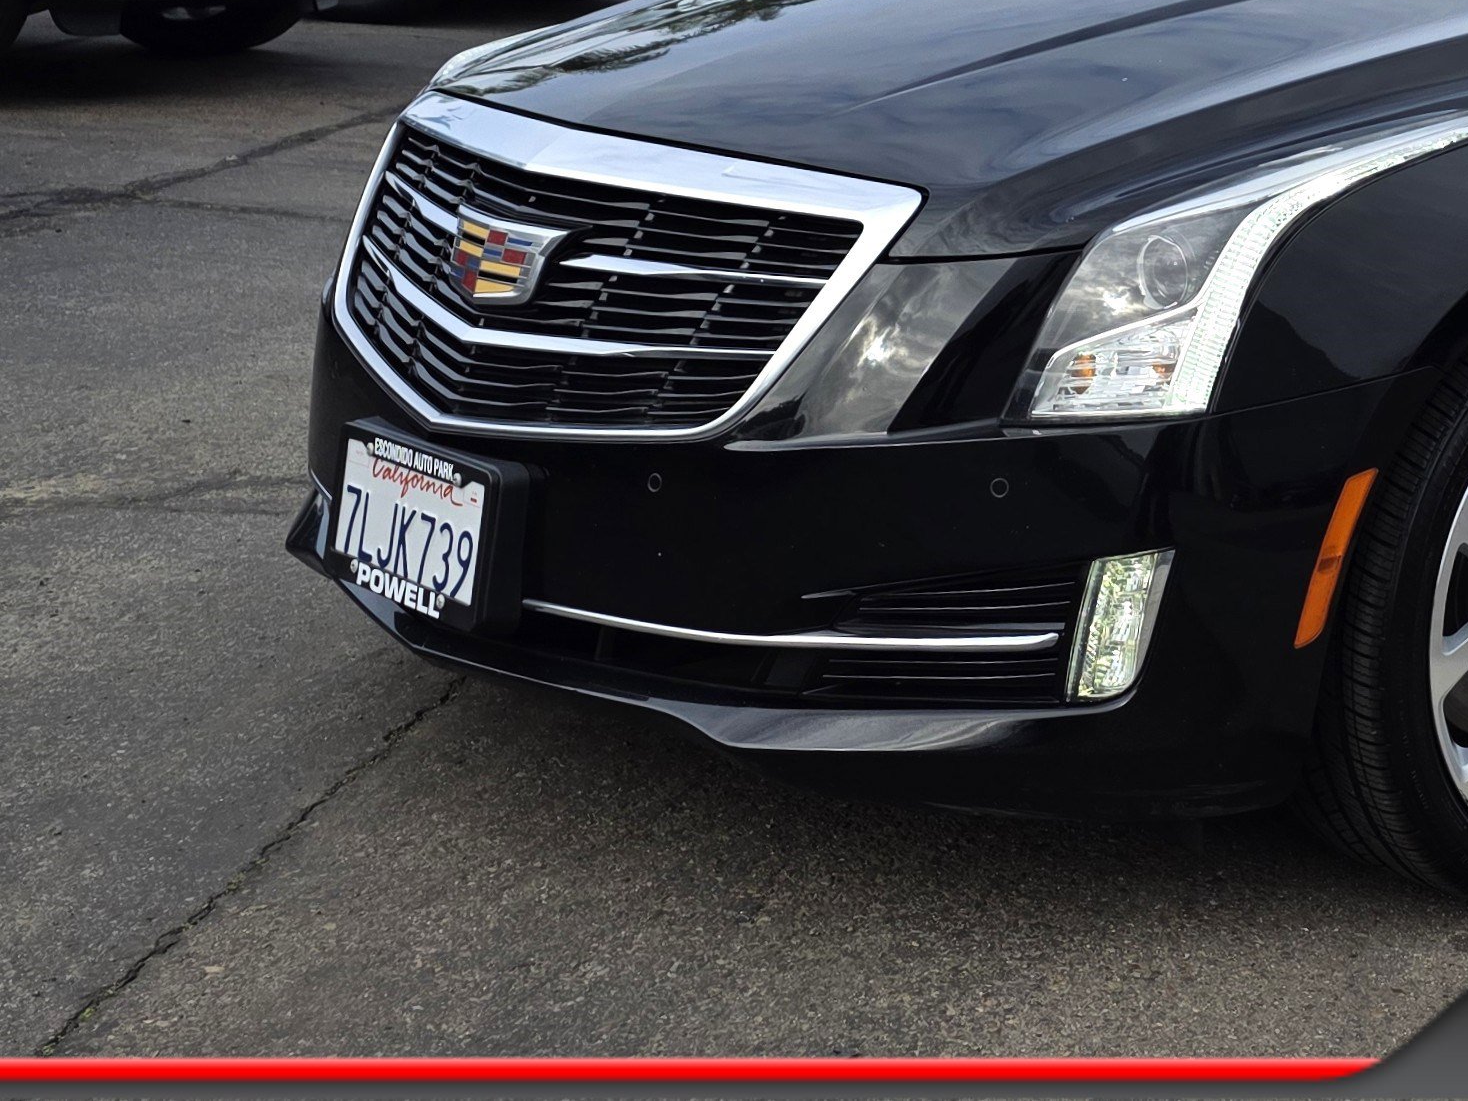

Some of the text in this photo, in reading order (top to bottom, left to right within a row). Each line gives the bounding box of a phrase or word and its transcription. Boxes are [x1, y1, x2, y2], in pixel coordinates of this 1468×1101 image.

[372, 458, 463, 507] California
[374, 437, 455, 481] ESCONDIDO AUTO PARK
[344, 484, 474, 598] 7LJK739
[356, 563, 440, 619] POWELL
